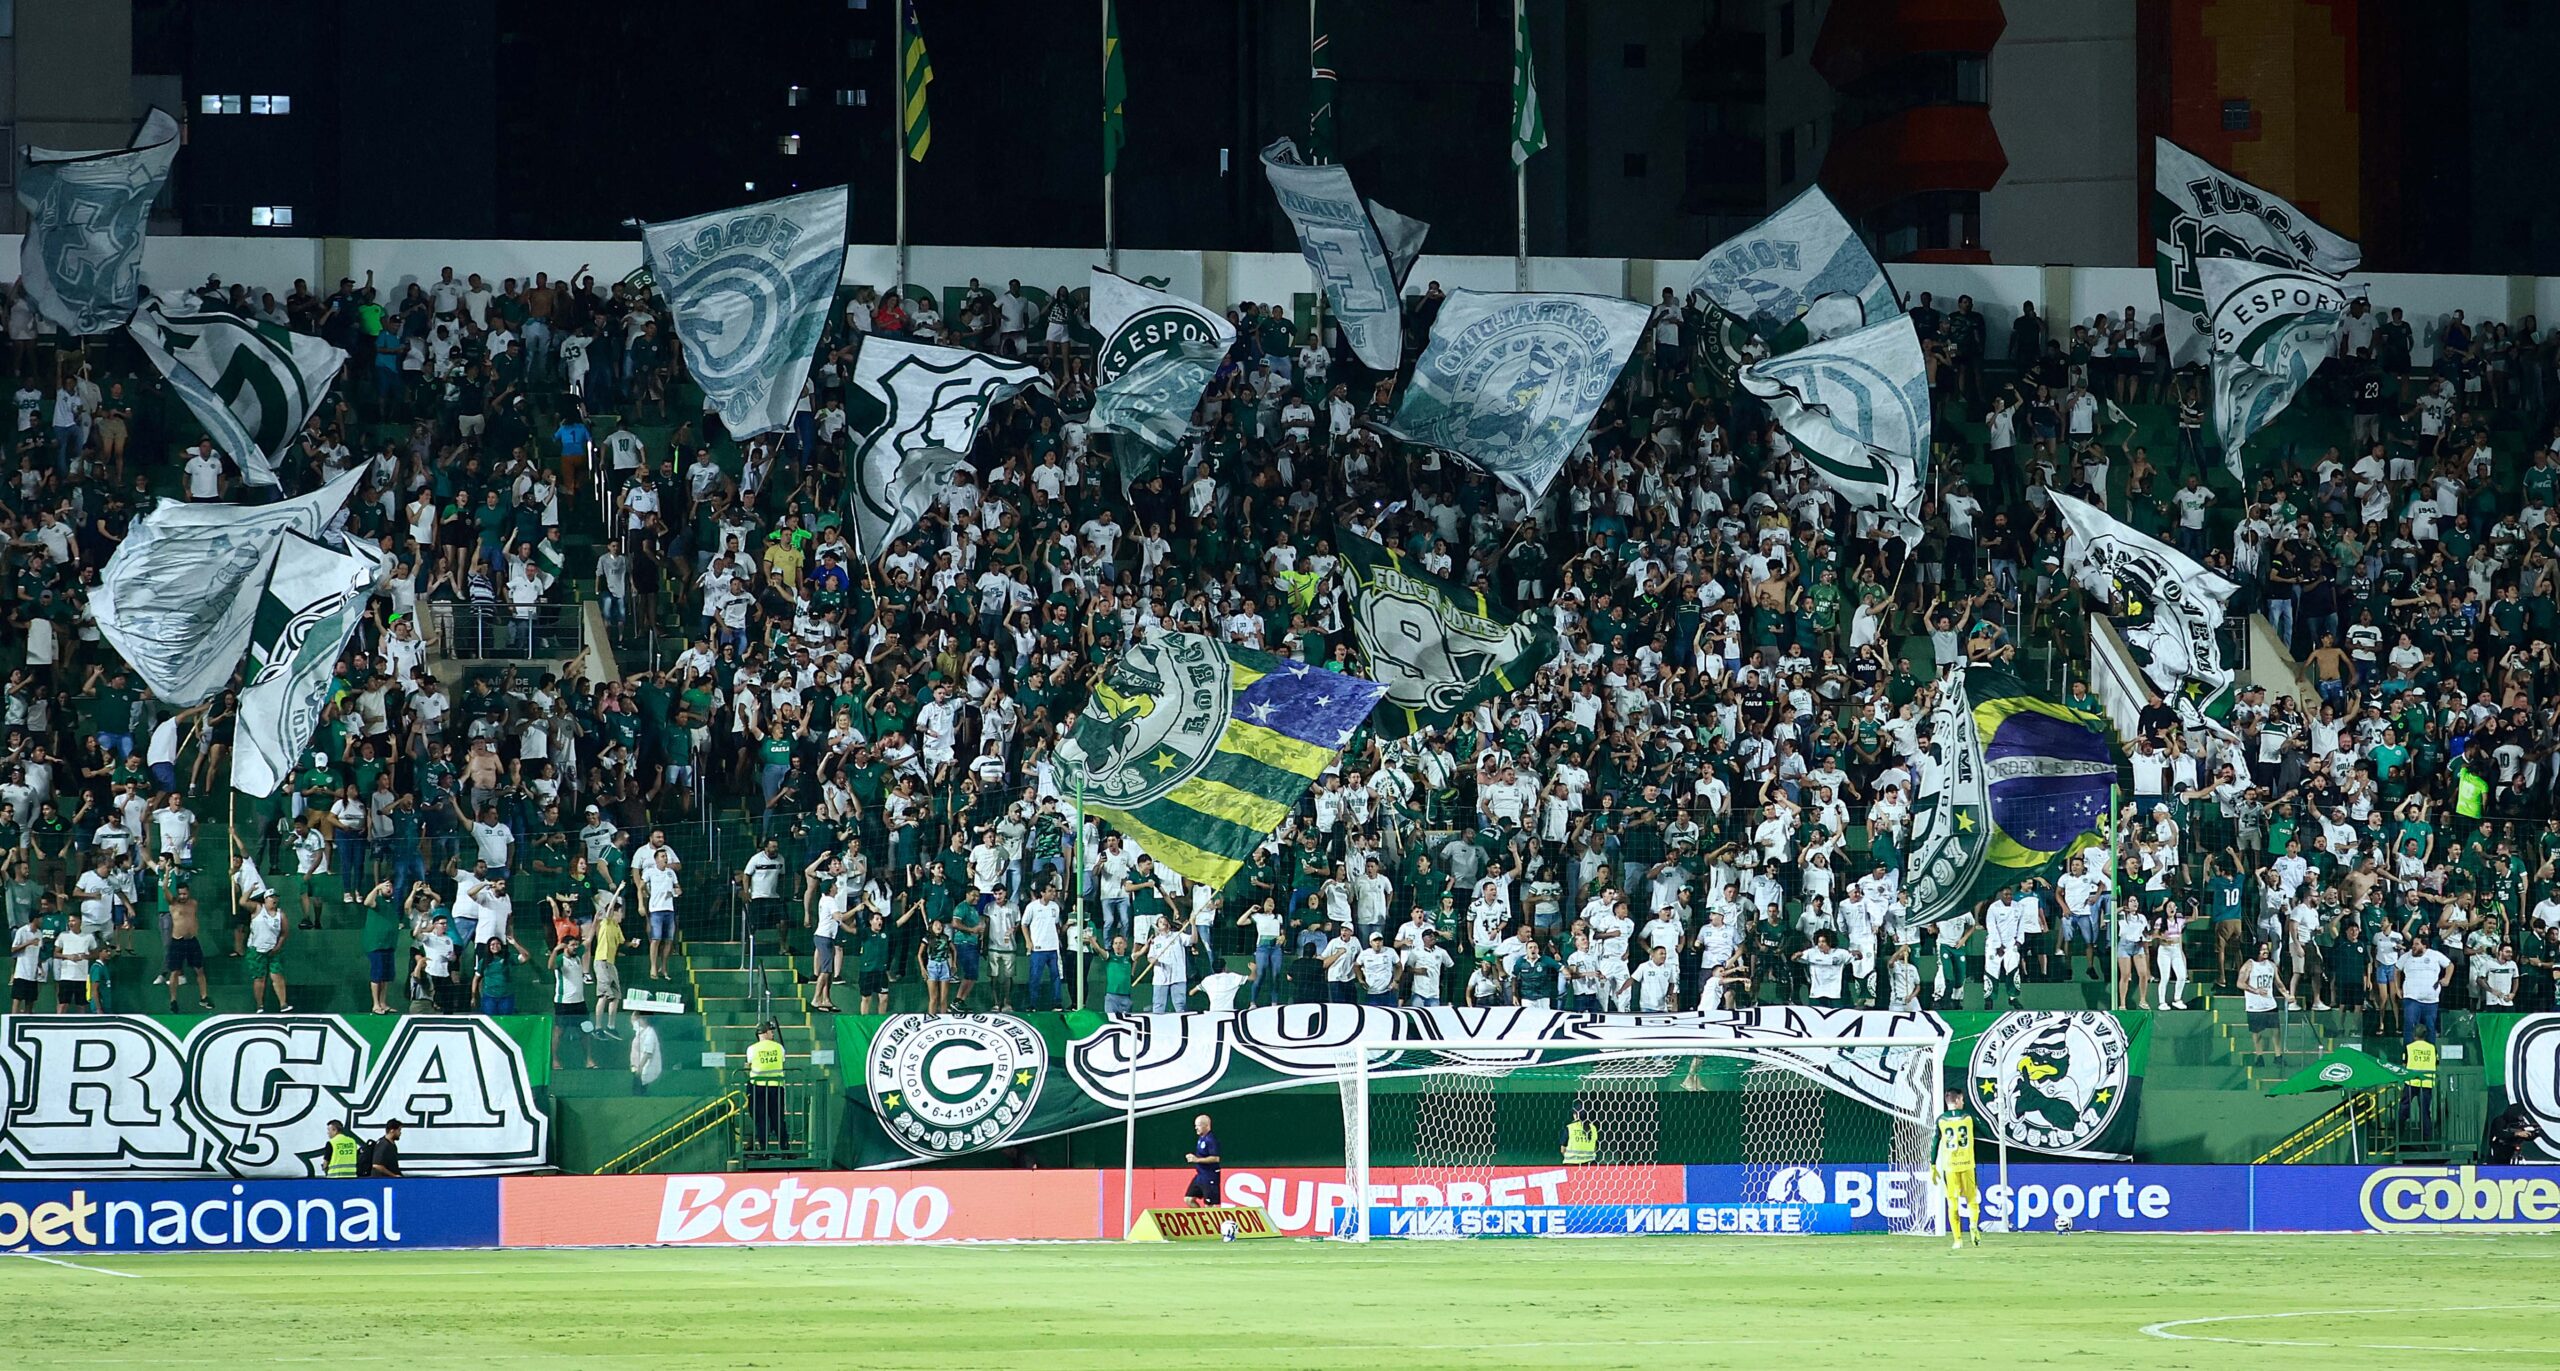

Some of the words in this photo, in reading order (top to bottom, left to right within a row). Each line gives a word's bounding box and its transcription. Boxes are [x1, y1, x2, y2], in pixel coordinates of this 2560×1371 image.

[1130, 320, 1213, 353] ESPO
[2364, 382, 2379, 399] 23
[618, 438, 630, 452] 10
[1441, 596, 1509, 638] JOVE
[1857, 664, 1877, 672] Philco
[1987, 755, 2045, 782] ORDEM
[2054, 761, 2066, 775] E
[2499, 752, 2510, 769] 10
[2223, 888, 2241, 907] 10
[877, 1013, 942, 1078] FORÇA
[760, 1056, 778, 1064] 0144
[906, 1052, 921, 1099] GOIÁS
[917, 1027, 987, 1050] ESPORTE
[989, 1039, 1009, 1082] CLUBE
[0, 1014, 549, 1177] RÇA
[893, 1090, 1024, 1151] 23-05-1997
[932, 1097, 989, 1120] 6-4-1943
[1944, 1125, 1969, 1149] 23
[656, 1175, 950, 1242] Betano
[1626, 1208, 1691, 1233] VIVA
[1696, 1208, 1801, 1232] SORTE
[1389, 1209, 1451, 1234] VIVA
[1461, 1209, 1569, 1233] SORTE
